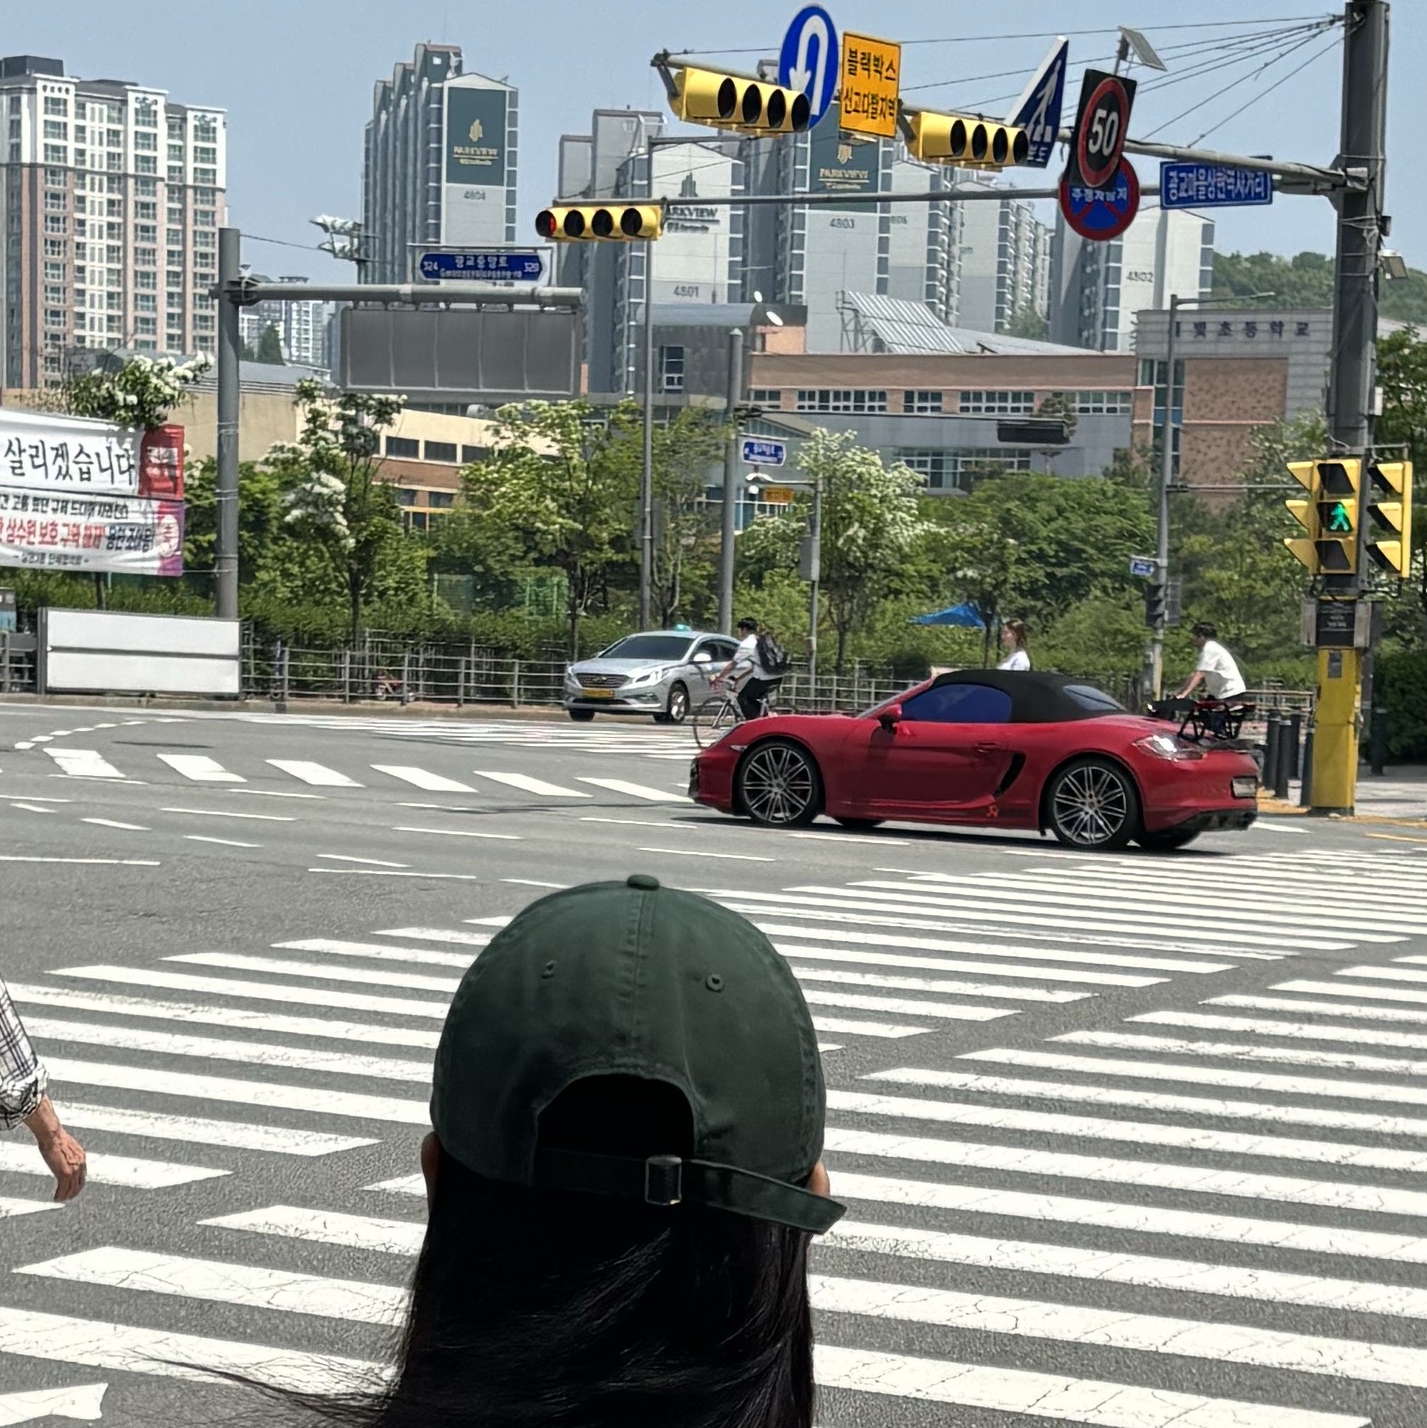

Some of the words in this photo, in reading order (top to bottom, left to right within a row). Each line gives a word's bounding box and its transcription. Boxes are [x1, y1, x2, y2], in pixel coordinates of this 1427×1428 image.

[847, 48, 896, 82] 블랙박스
[843, 86, 896, 124] 신고다발지역
[1088, 108, 1119, 157] 50
[673, 285, 700, 298] 4801
[4, 437, 136, 486] 살리겠습니다
[38, 521, 58, 546] 보호
